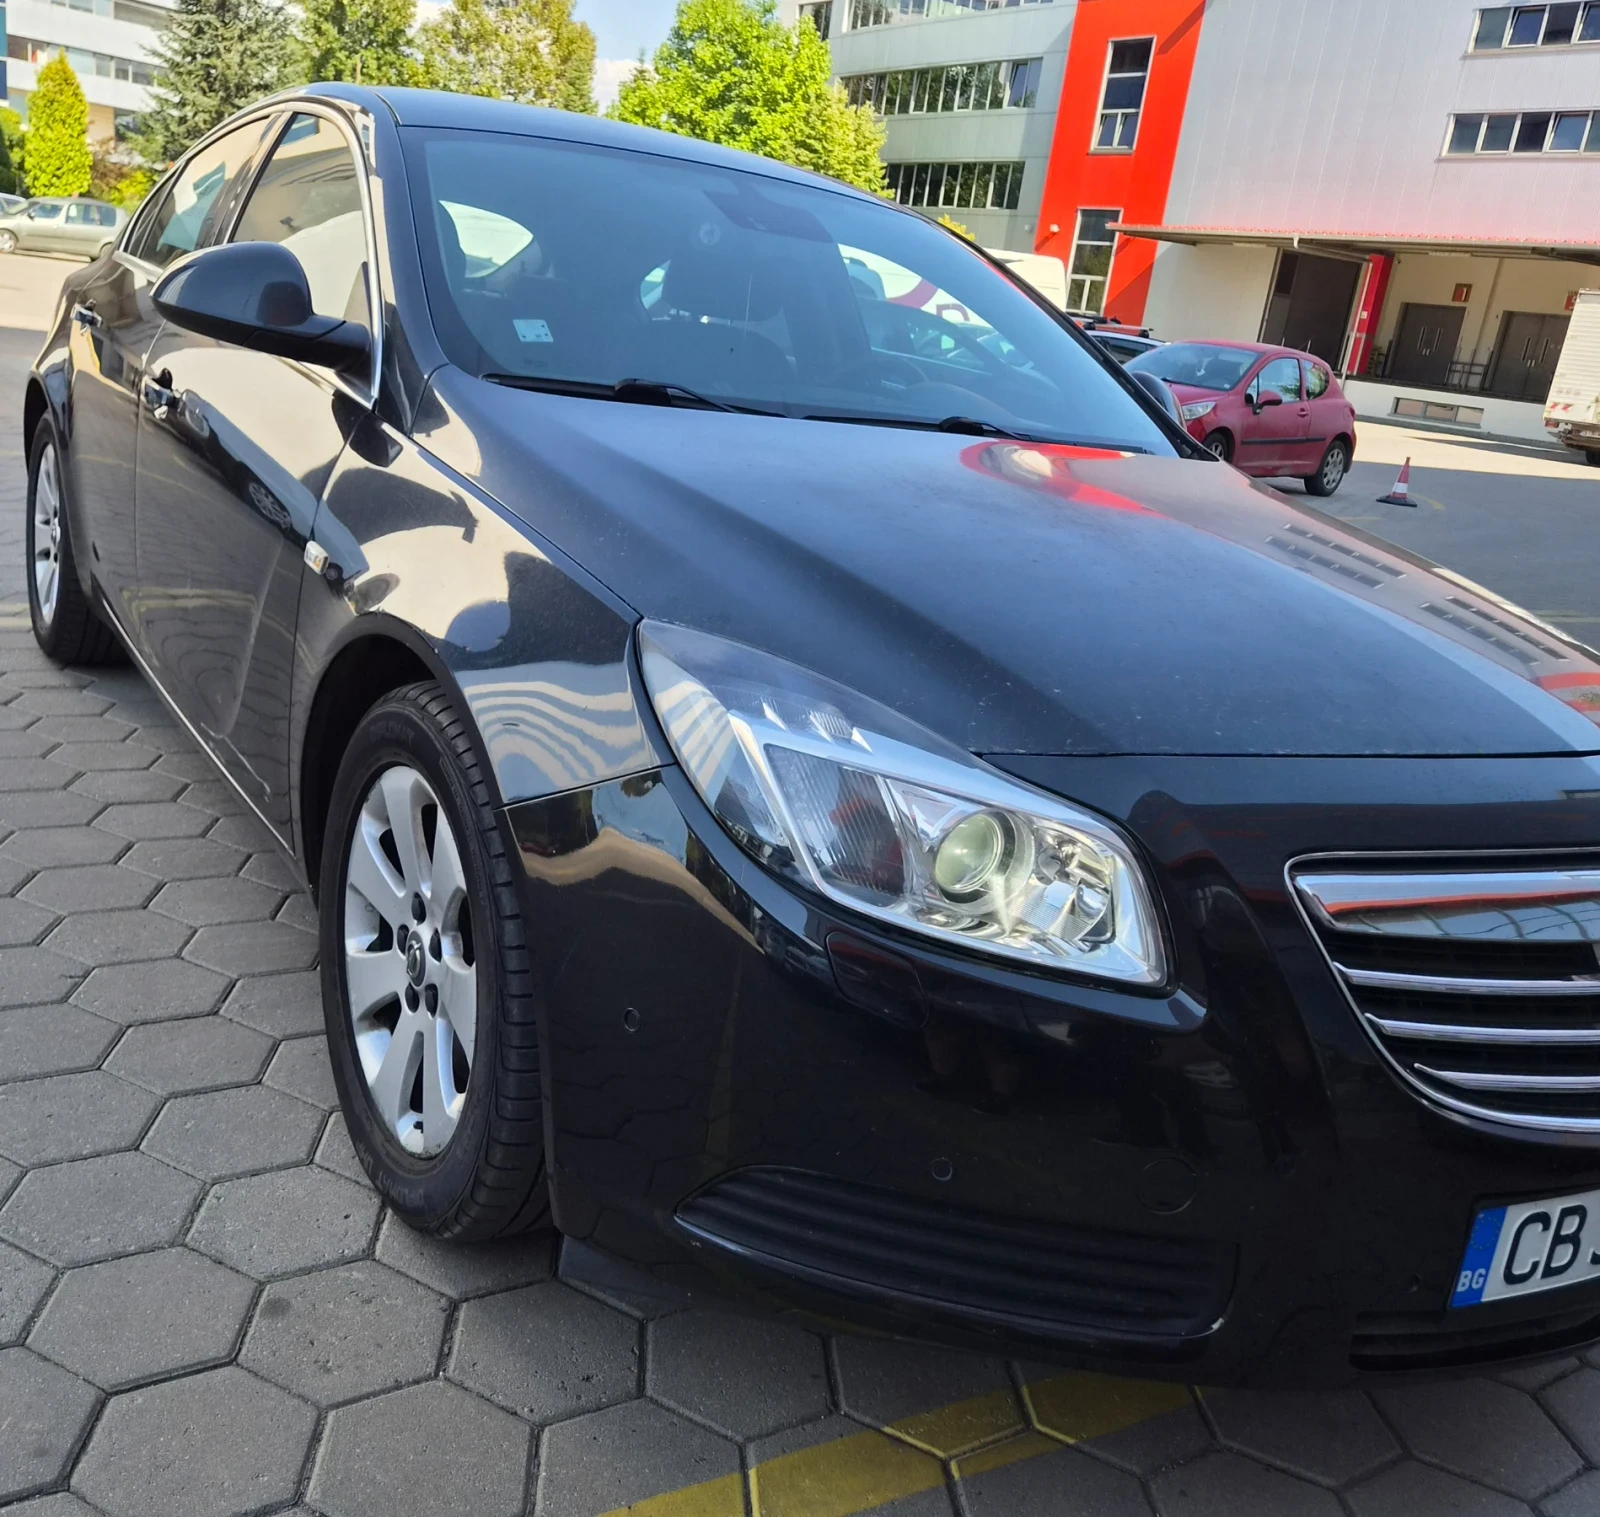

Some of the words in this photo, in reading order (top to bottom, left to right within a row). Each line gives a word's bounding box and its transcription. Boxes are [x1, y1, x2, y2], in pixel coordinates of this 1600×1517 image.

[369, 720, 416, 747] DIPLOMAT
[375, 1170, 424, 1206] DIPLOMAT
[1456, 1269, 1487, 1292] BG
